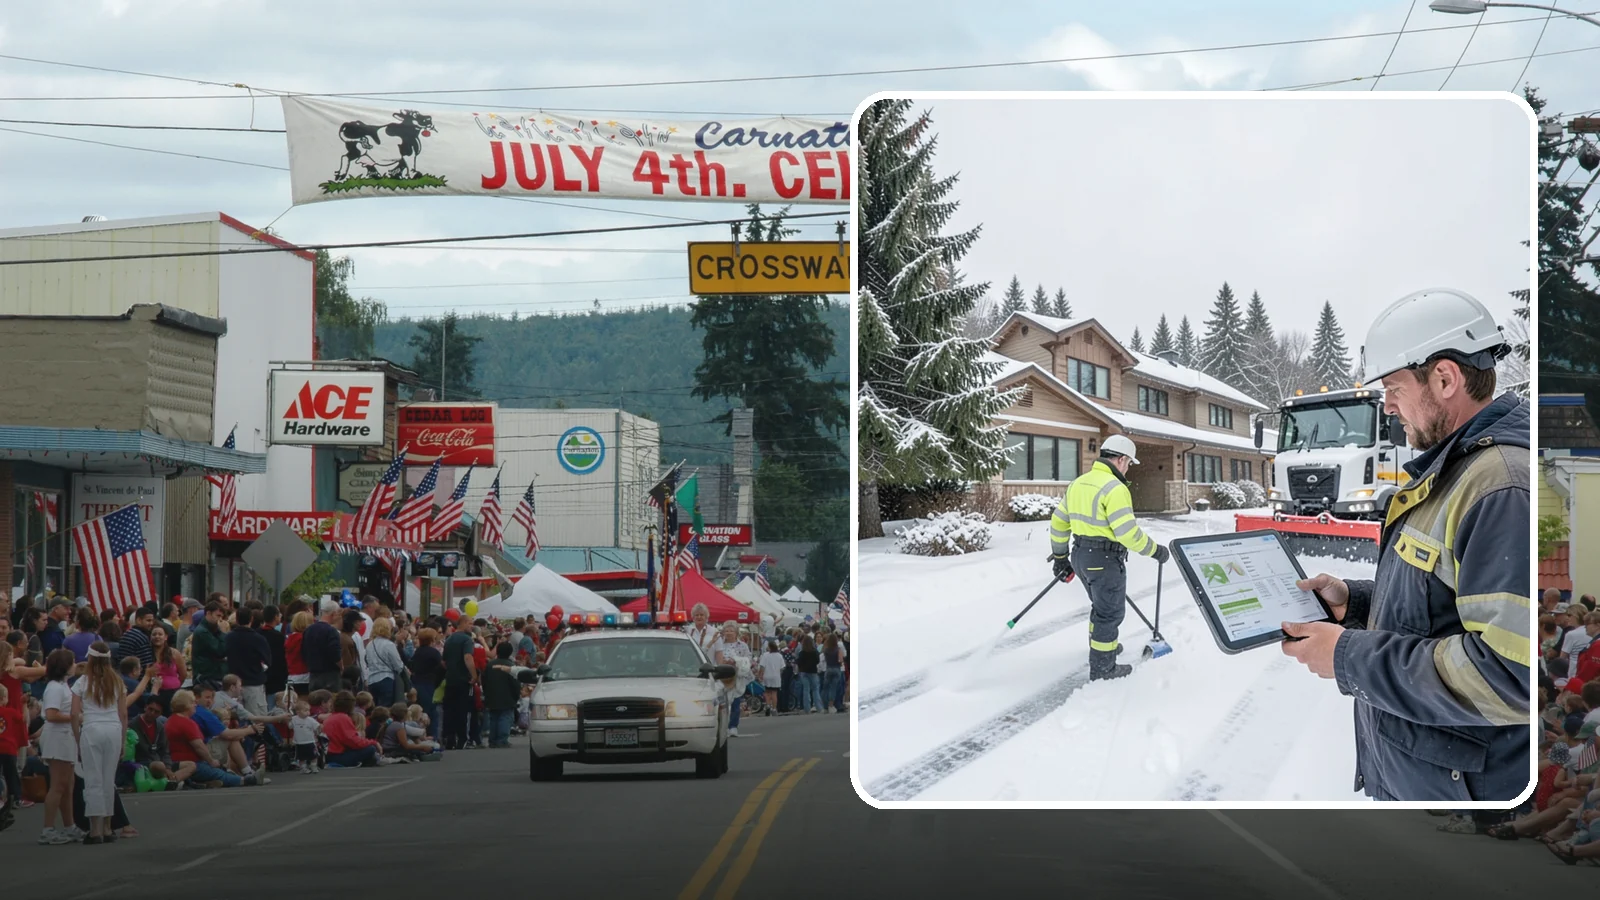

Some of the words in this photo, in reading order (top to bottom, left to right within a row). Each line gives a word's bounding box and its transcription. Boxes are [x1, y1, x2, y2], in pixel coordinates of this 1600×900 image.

[481, 141, 605, 193] JULY
[632, 150, 746, 198] 4th.
[697, 254, 850, 280] CROSSWA
[283, 380, 373, 419] ACE
[406, 409, 452, 422] CEDAR
[461, 409, 485, 421] LOG
[283, 421, 371, 436] Hardware
[416, 428, 477, 447] Coca-Cola
[353, 467, 386, 483] Simpl
[96, 485, 124, 495] Vincent
[126, 486, 136, 495] de
[138, 486, 155, 495] Paul
[688, 527, 741, 535] CRNATION
[699, 535, 730, 543] GLASS
